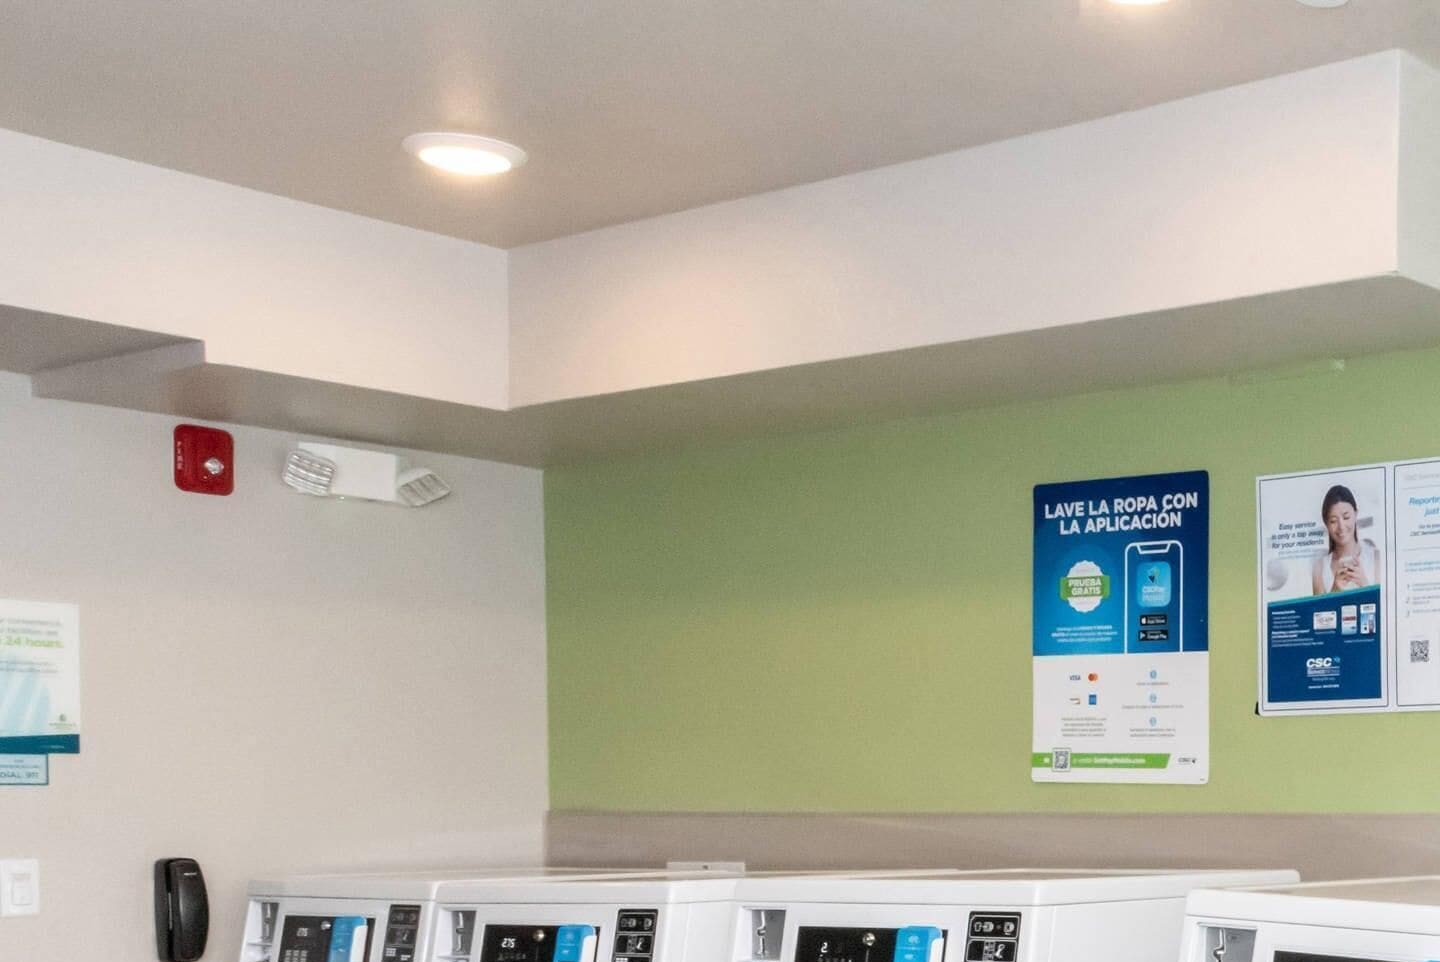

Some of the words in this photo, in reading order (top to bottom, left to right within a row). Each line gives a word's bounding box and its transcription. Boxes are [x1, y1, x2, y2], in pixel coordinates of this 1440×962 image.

[1045, 501, 1085, 519] LAVE
[1088, 500, 1110, 515] LA
[1114, 496, 1158, 514] ROPA
[1162, 492, 1198, 510] CON
[1060, 520, 1080, 535] LA
[1084, 510, 1181, 533] APLICACIÓN
[1068, 578, 1102, 587] PRUEBA
[1072, 586, 1101, 596] GRATIS
[1306, 657, 1332, 668] CSC
[821, 942, 828, 953] 2
